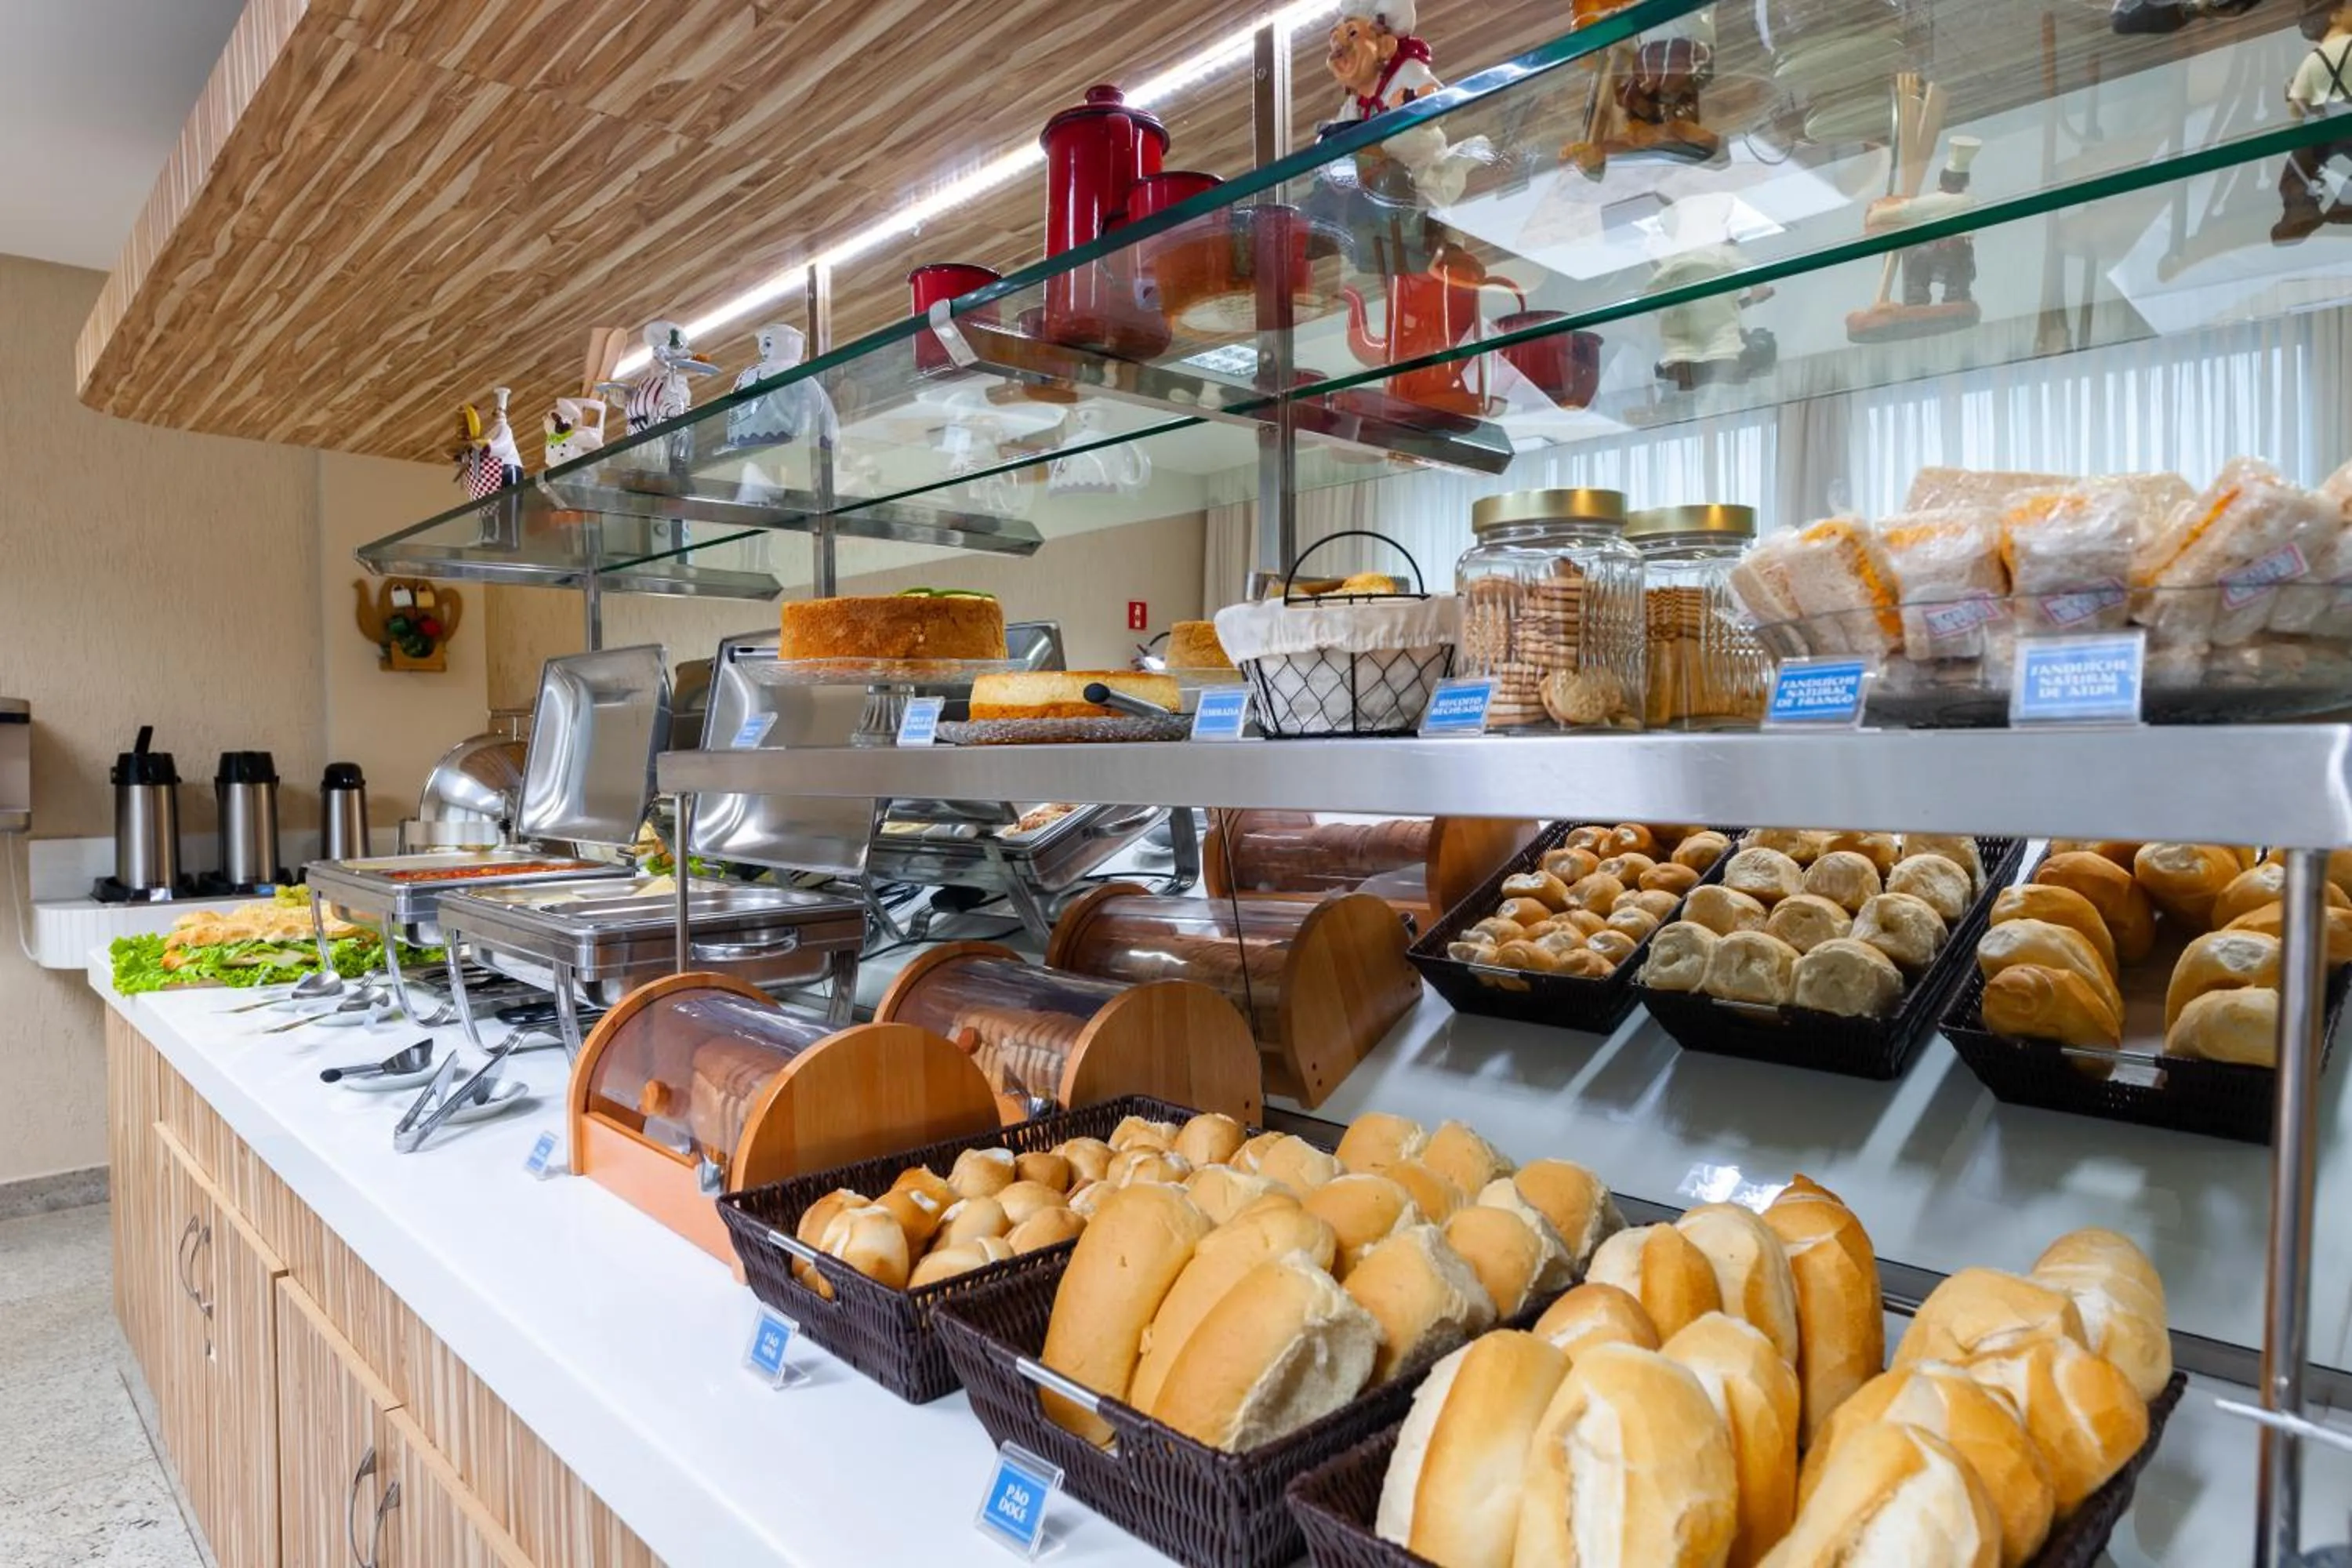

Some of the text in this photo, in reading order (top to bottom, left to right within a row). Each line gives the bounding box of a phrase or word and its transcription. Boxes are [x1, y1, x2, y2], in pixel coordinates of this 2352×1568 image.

[2038, 673, 2118, 686] NATURAL
[1786, 686, 1846, 697] NATURAL
[2038, 684, 2118, 699] DE ATUM
[1776, 694, 1855, 708] DE FRANGO
[1007, 1483, 1029, 1506] PÃO
